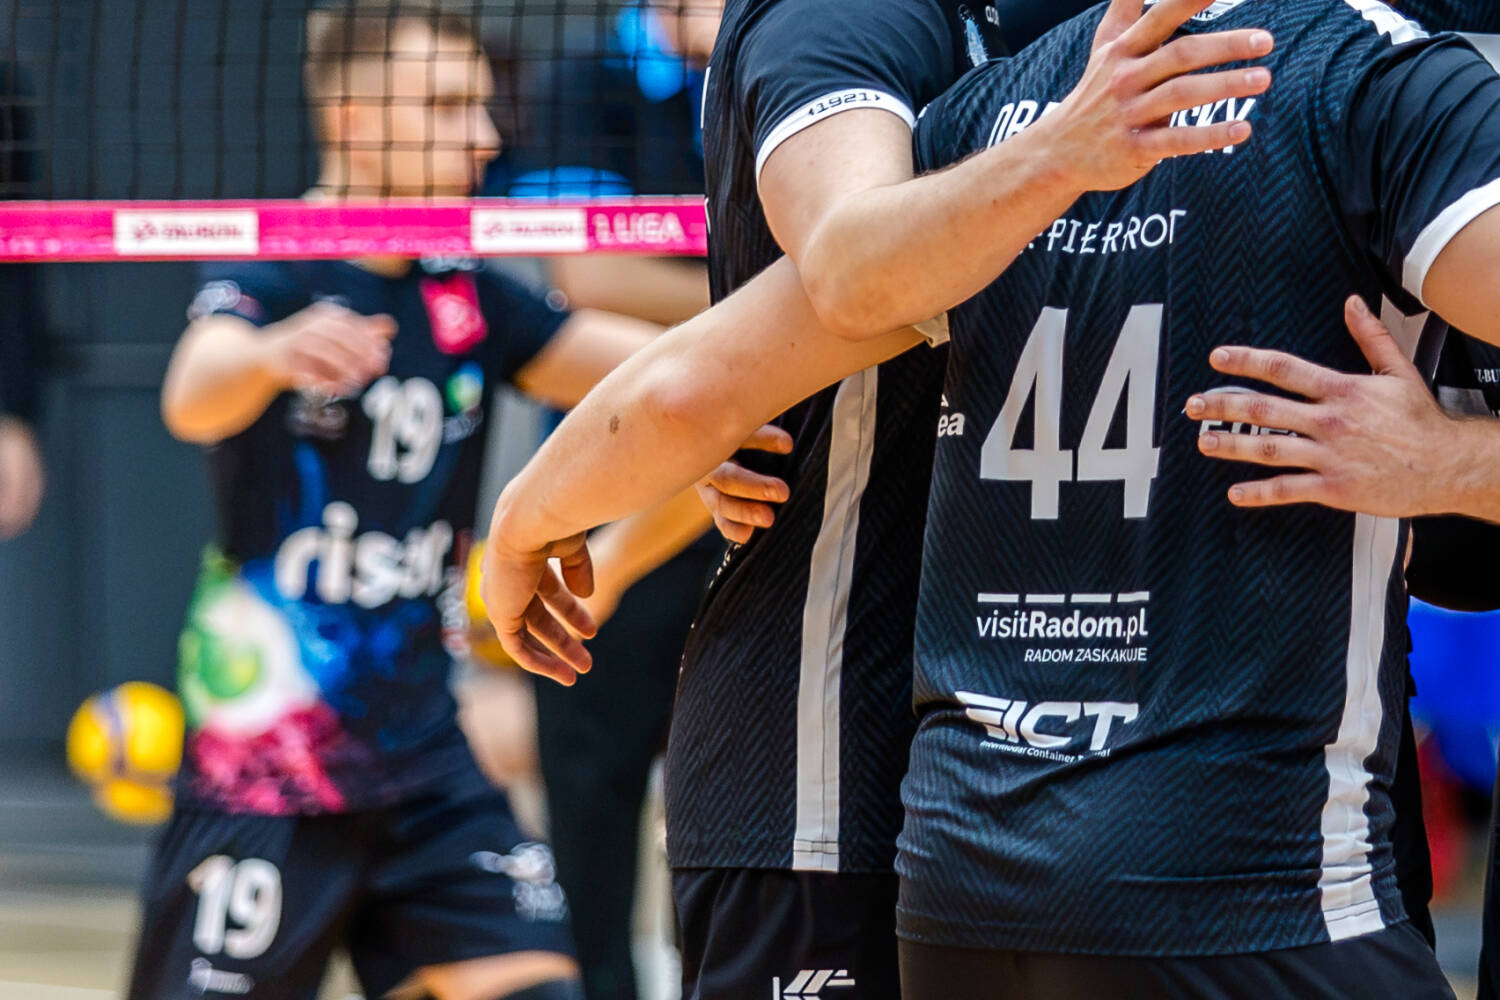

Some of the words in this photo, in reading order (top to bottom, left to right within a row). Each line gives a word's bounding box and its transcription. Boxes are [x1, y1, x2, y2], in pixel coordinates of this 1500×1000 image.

[815, 92, 872, 114] 1921
[1047, 209, 1188, 255] PIERROT
[363, 375, 445, 485] 19
[980, 303, 1164, 520] 44
[976, 608, 1149, 645] visitRadom.pl
[1024, 649, 1073, 663] RADOM
[1075, 647, 1148, 662] ZASKAKUJE
[1026, 747, 1076, 763] Container
[187, 854, 283, 959] 19
